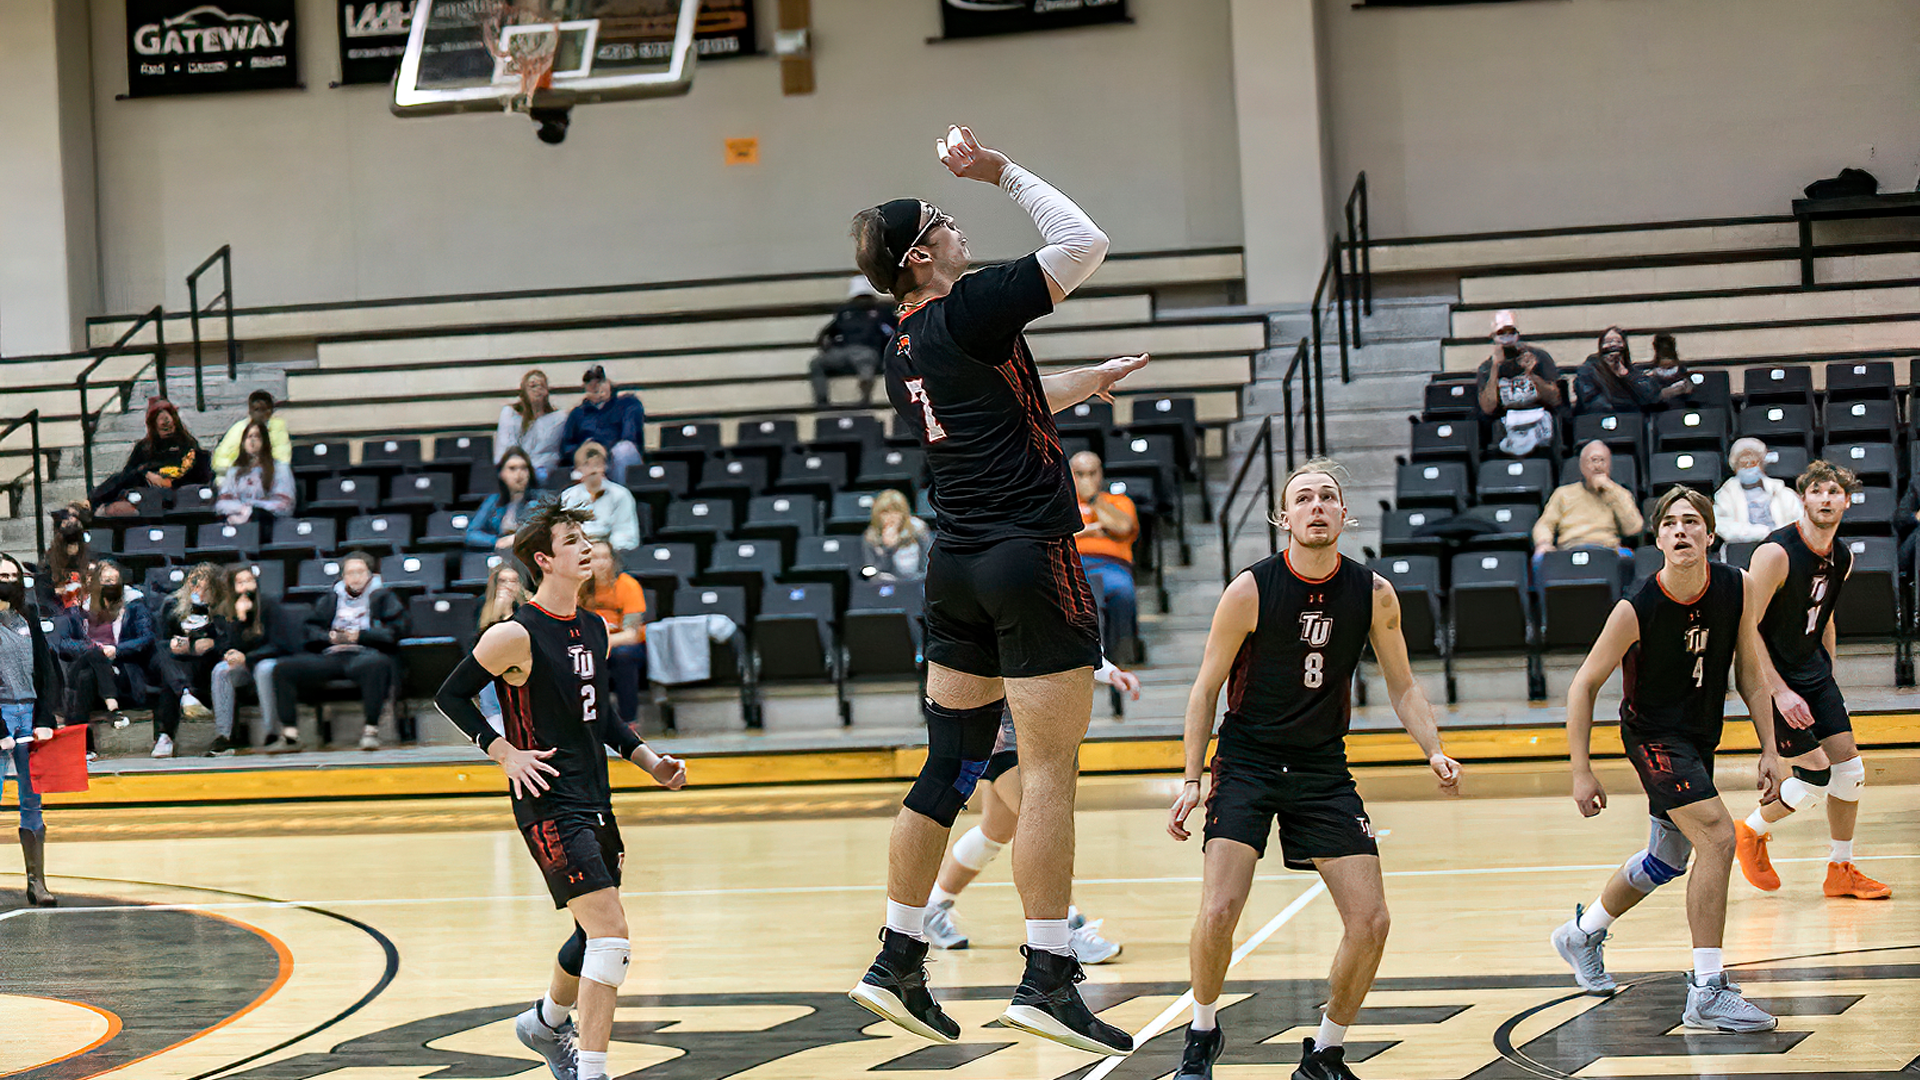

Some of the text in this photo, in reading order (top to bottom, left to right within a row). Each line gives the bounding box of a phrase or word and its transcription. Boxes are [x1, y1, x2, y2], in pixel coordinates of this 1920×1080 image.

[134, 20, 289, 55] GATEWAY
[904, 377, 948, 443] 7
[1299, 611, 1333, 648] TU
[567, 644, 595, 680] TU
[1303, 652, 1324, 689] 8
[1692, 656, 1704, 688] 4
[580, 684, 597, 722] 2
